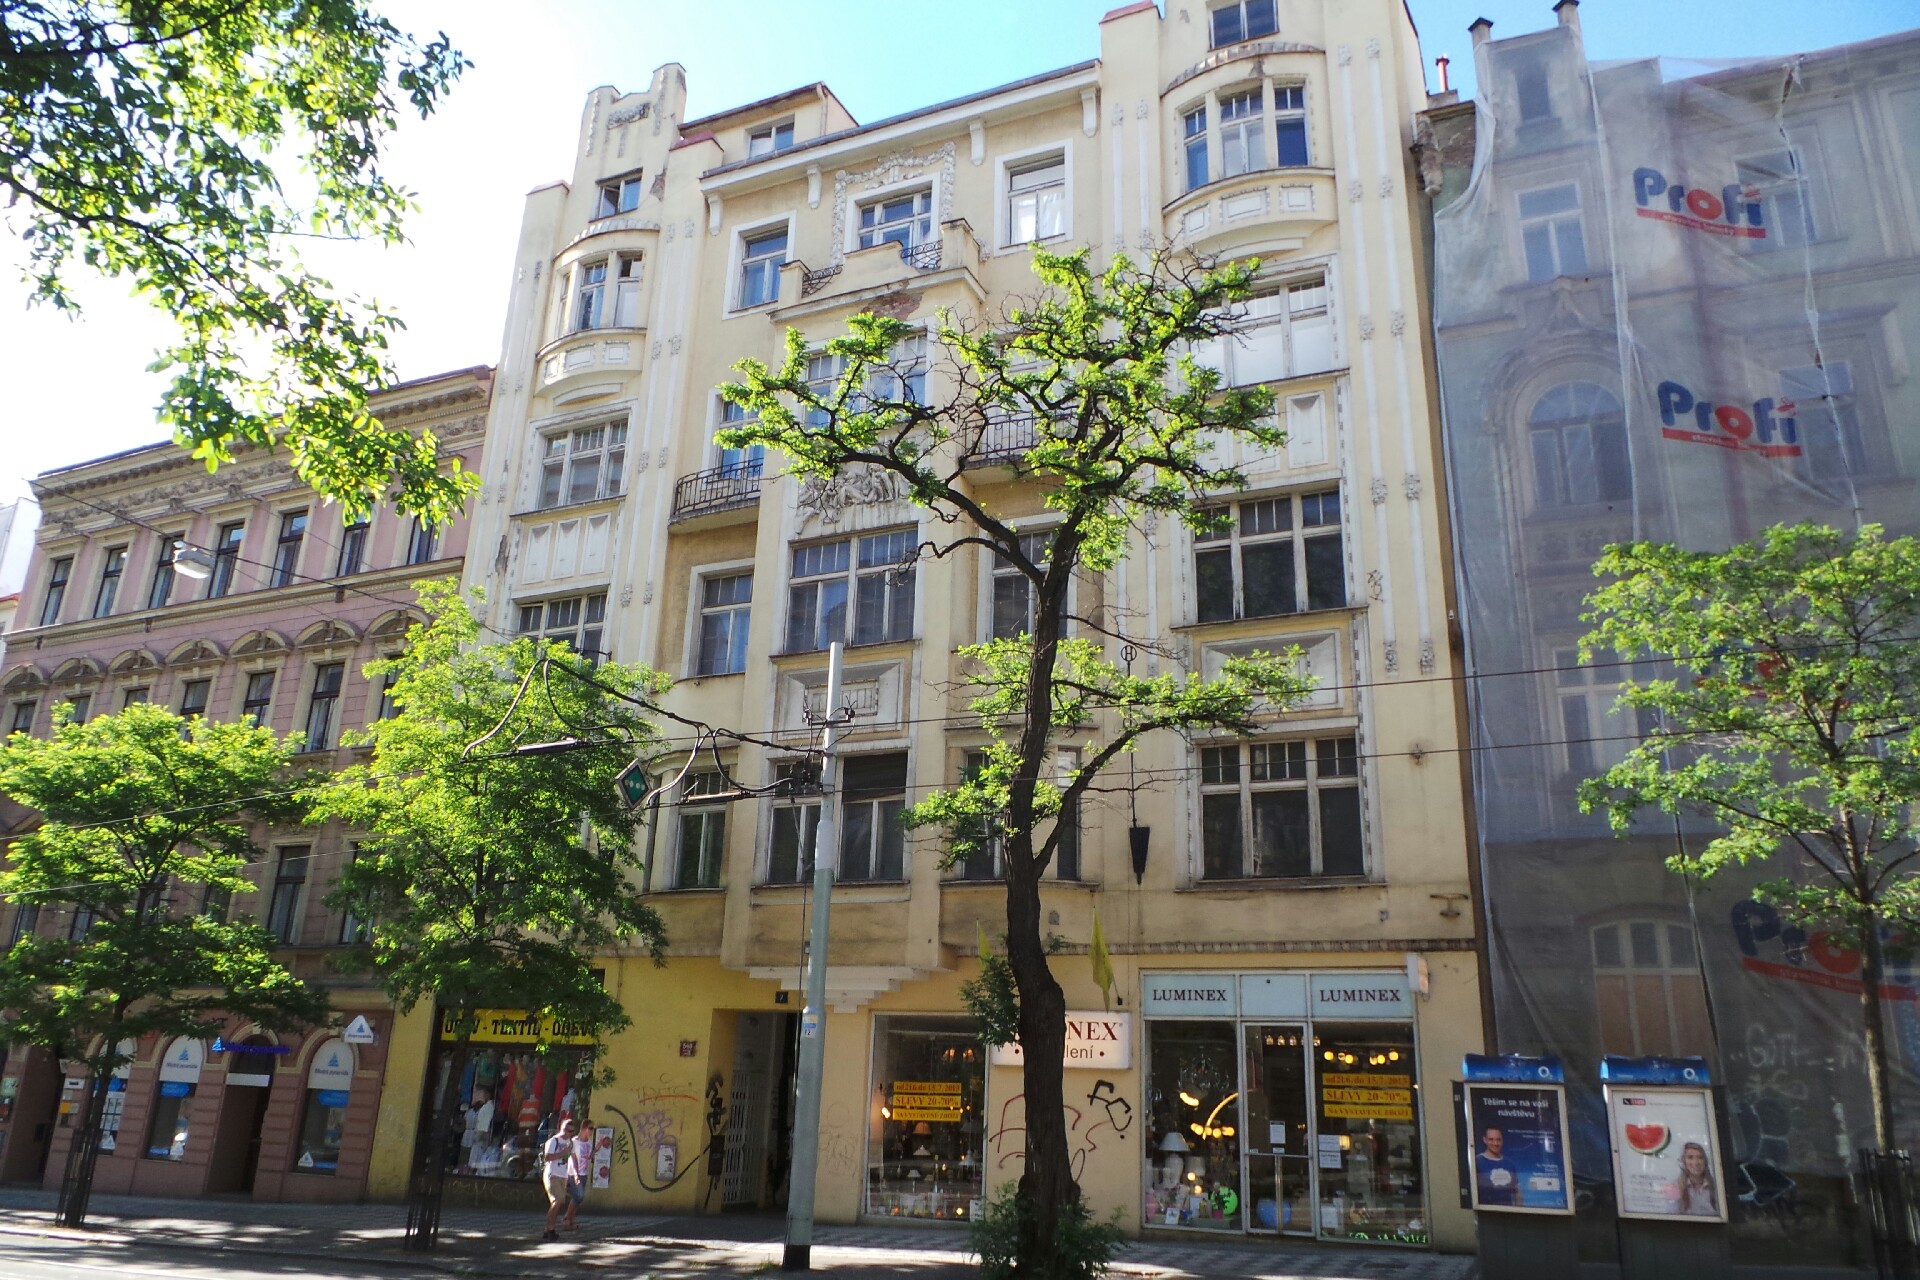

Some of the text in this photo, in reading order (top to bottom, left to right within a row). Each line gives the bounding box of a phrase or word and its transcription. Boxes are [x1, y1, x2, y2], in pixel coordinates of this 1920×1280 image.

[1633, 167, 1763, 227] Profi
[1657, 380, 1798, 445] Profi
[1152, 988, 1227, 1002] LUMINEX
[1320, 988, 1402, 1003] LUMINEX
[1326, 1089, 1361, 1100] SLEVY
[1508, 1099, 1518, 1107] se
[1519, 1099, 1531, 1107] na
